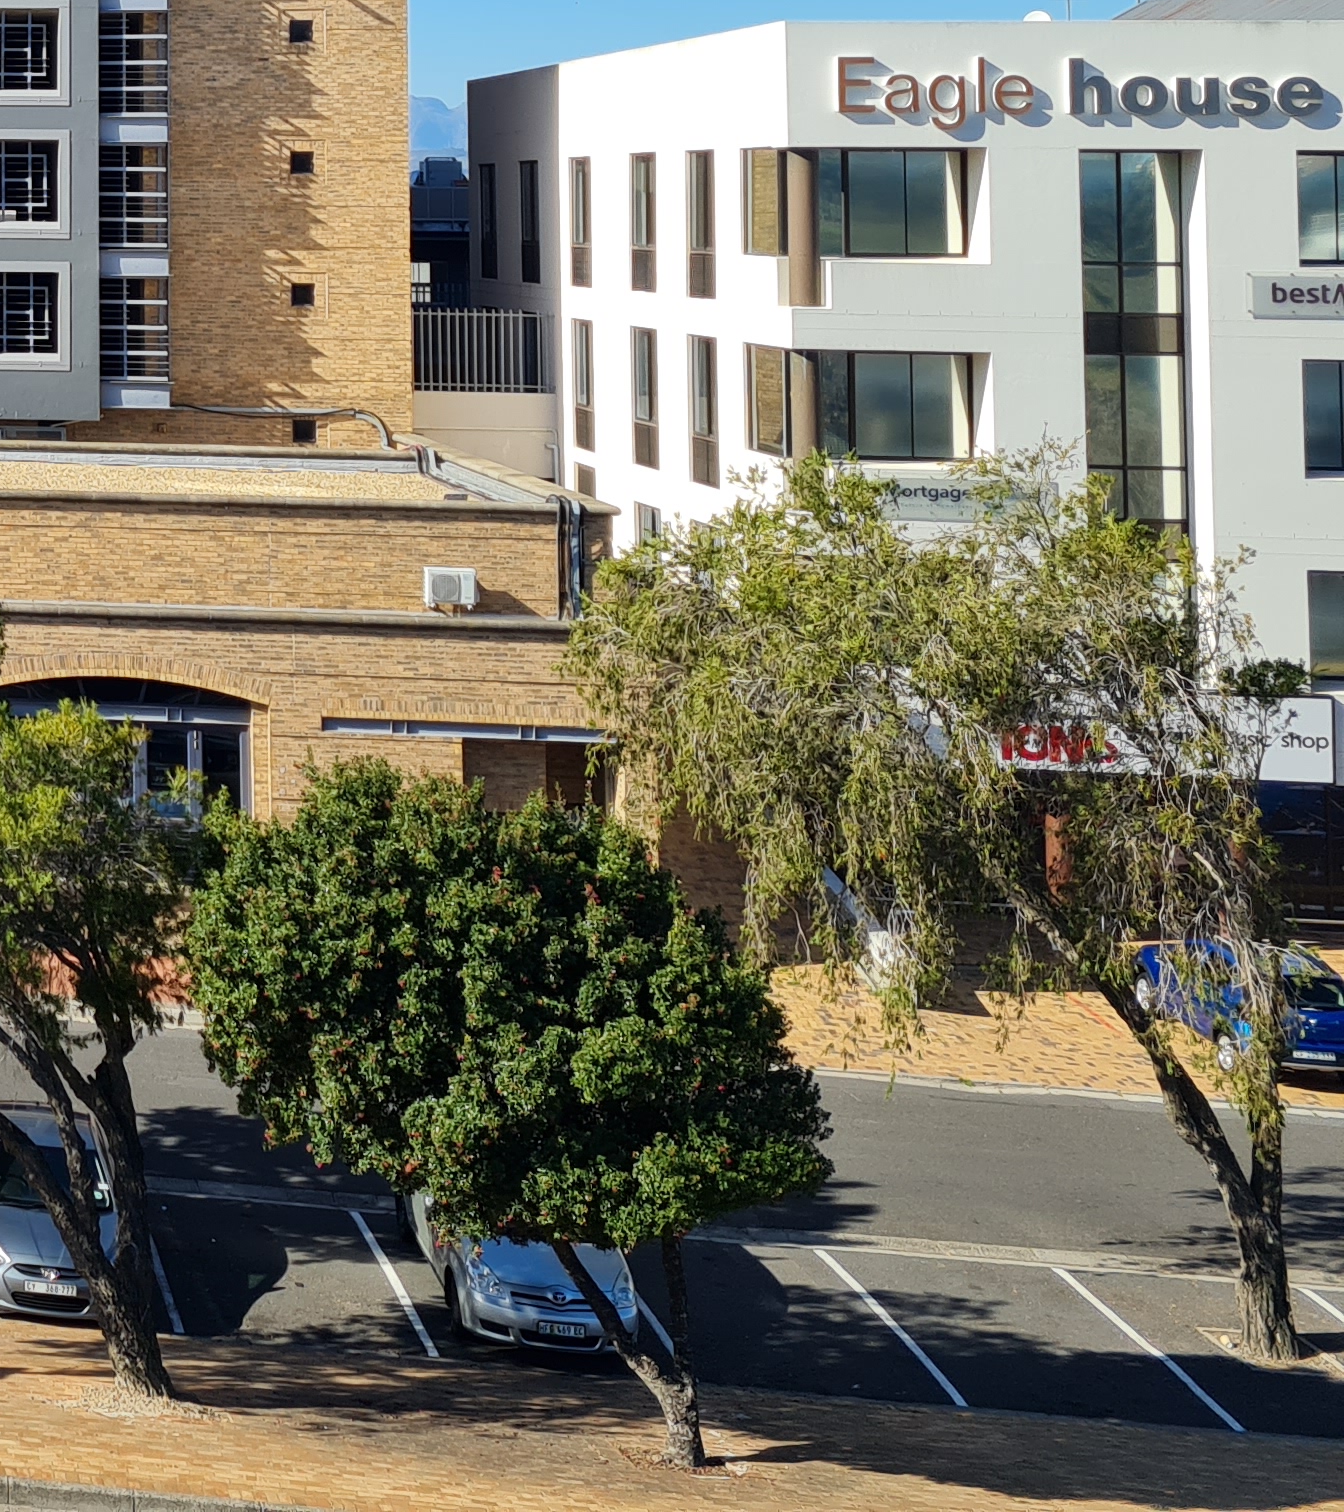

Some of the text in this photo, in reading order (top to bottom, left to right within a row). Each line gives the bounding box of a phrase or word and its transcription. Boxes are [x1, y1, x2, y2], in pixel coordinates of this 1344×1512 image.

[836, 57, 1325, 130] Eagle house
[1281, 732, 1330, 753] shop
